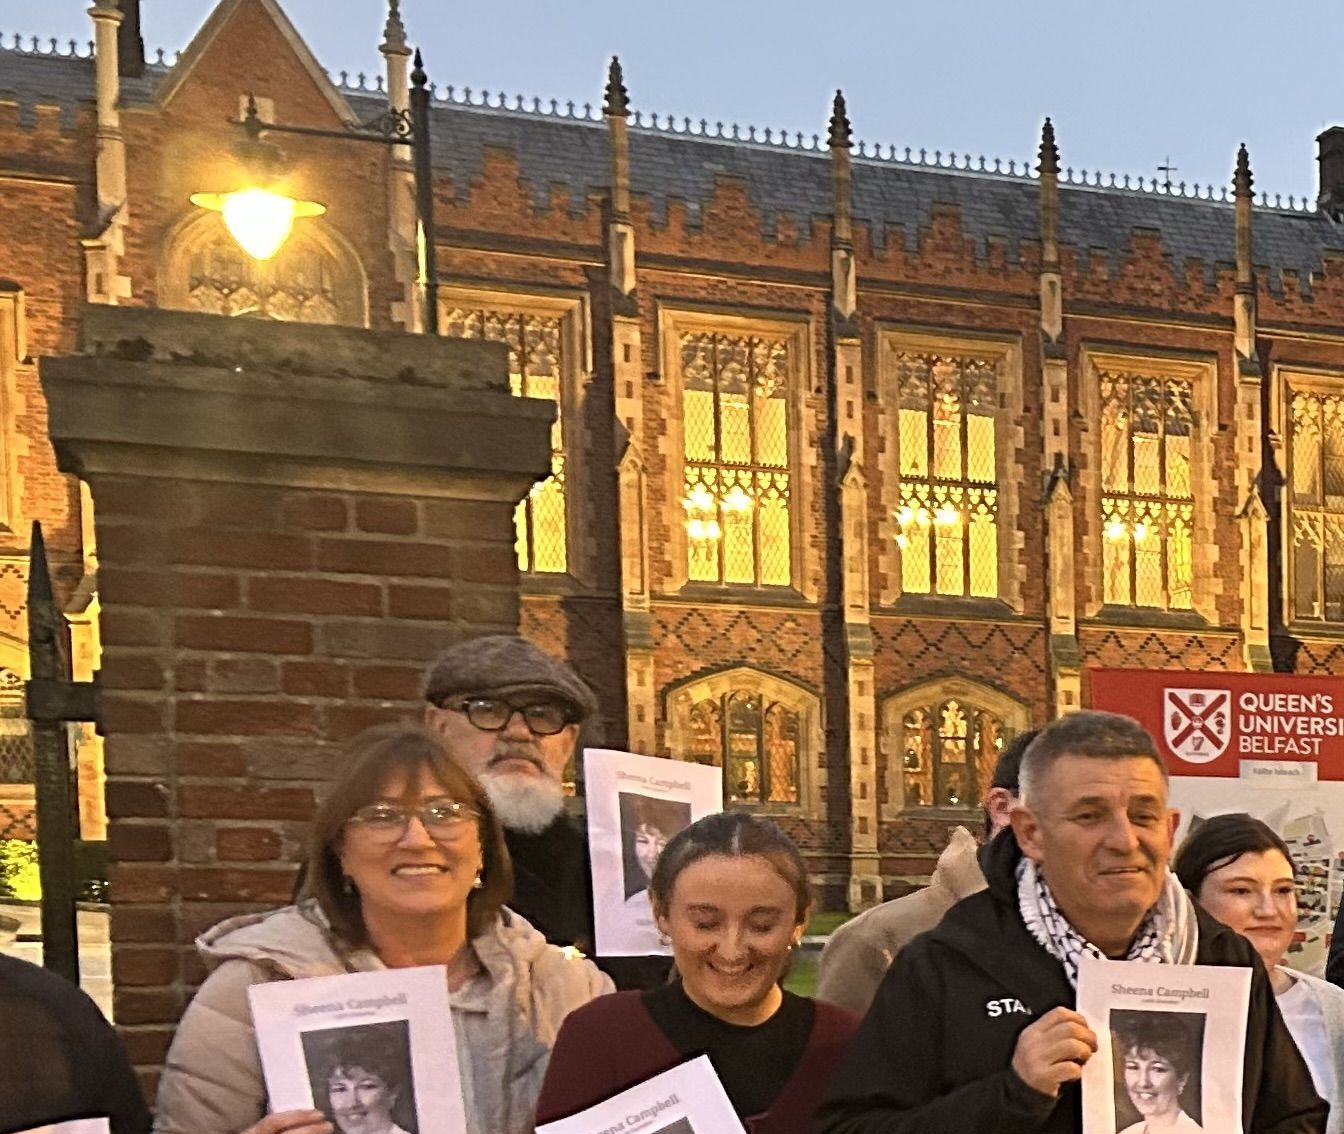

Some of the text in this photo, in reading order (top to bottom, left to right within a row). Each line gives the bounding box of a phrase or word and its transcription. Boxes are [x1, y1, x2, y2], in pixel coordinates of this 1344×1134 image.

[1239, 692, 1333, 714] QUEEN'S
[1239, 736, 1323, 755] BELFAST
[1111, 983, 1210, 1001] Sheena Campbell
[625, 1092, 680, 1126] Campbell
